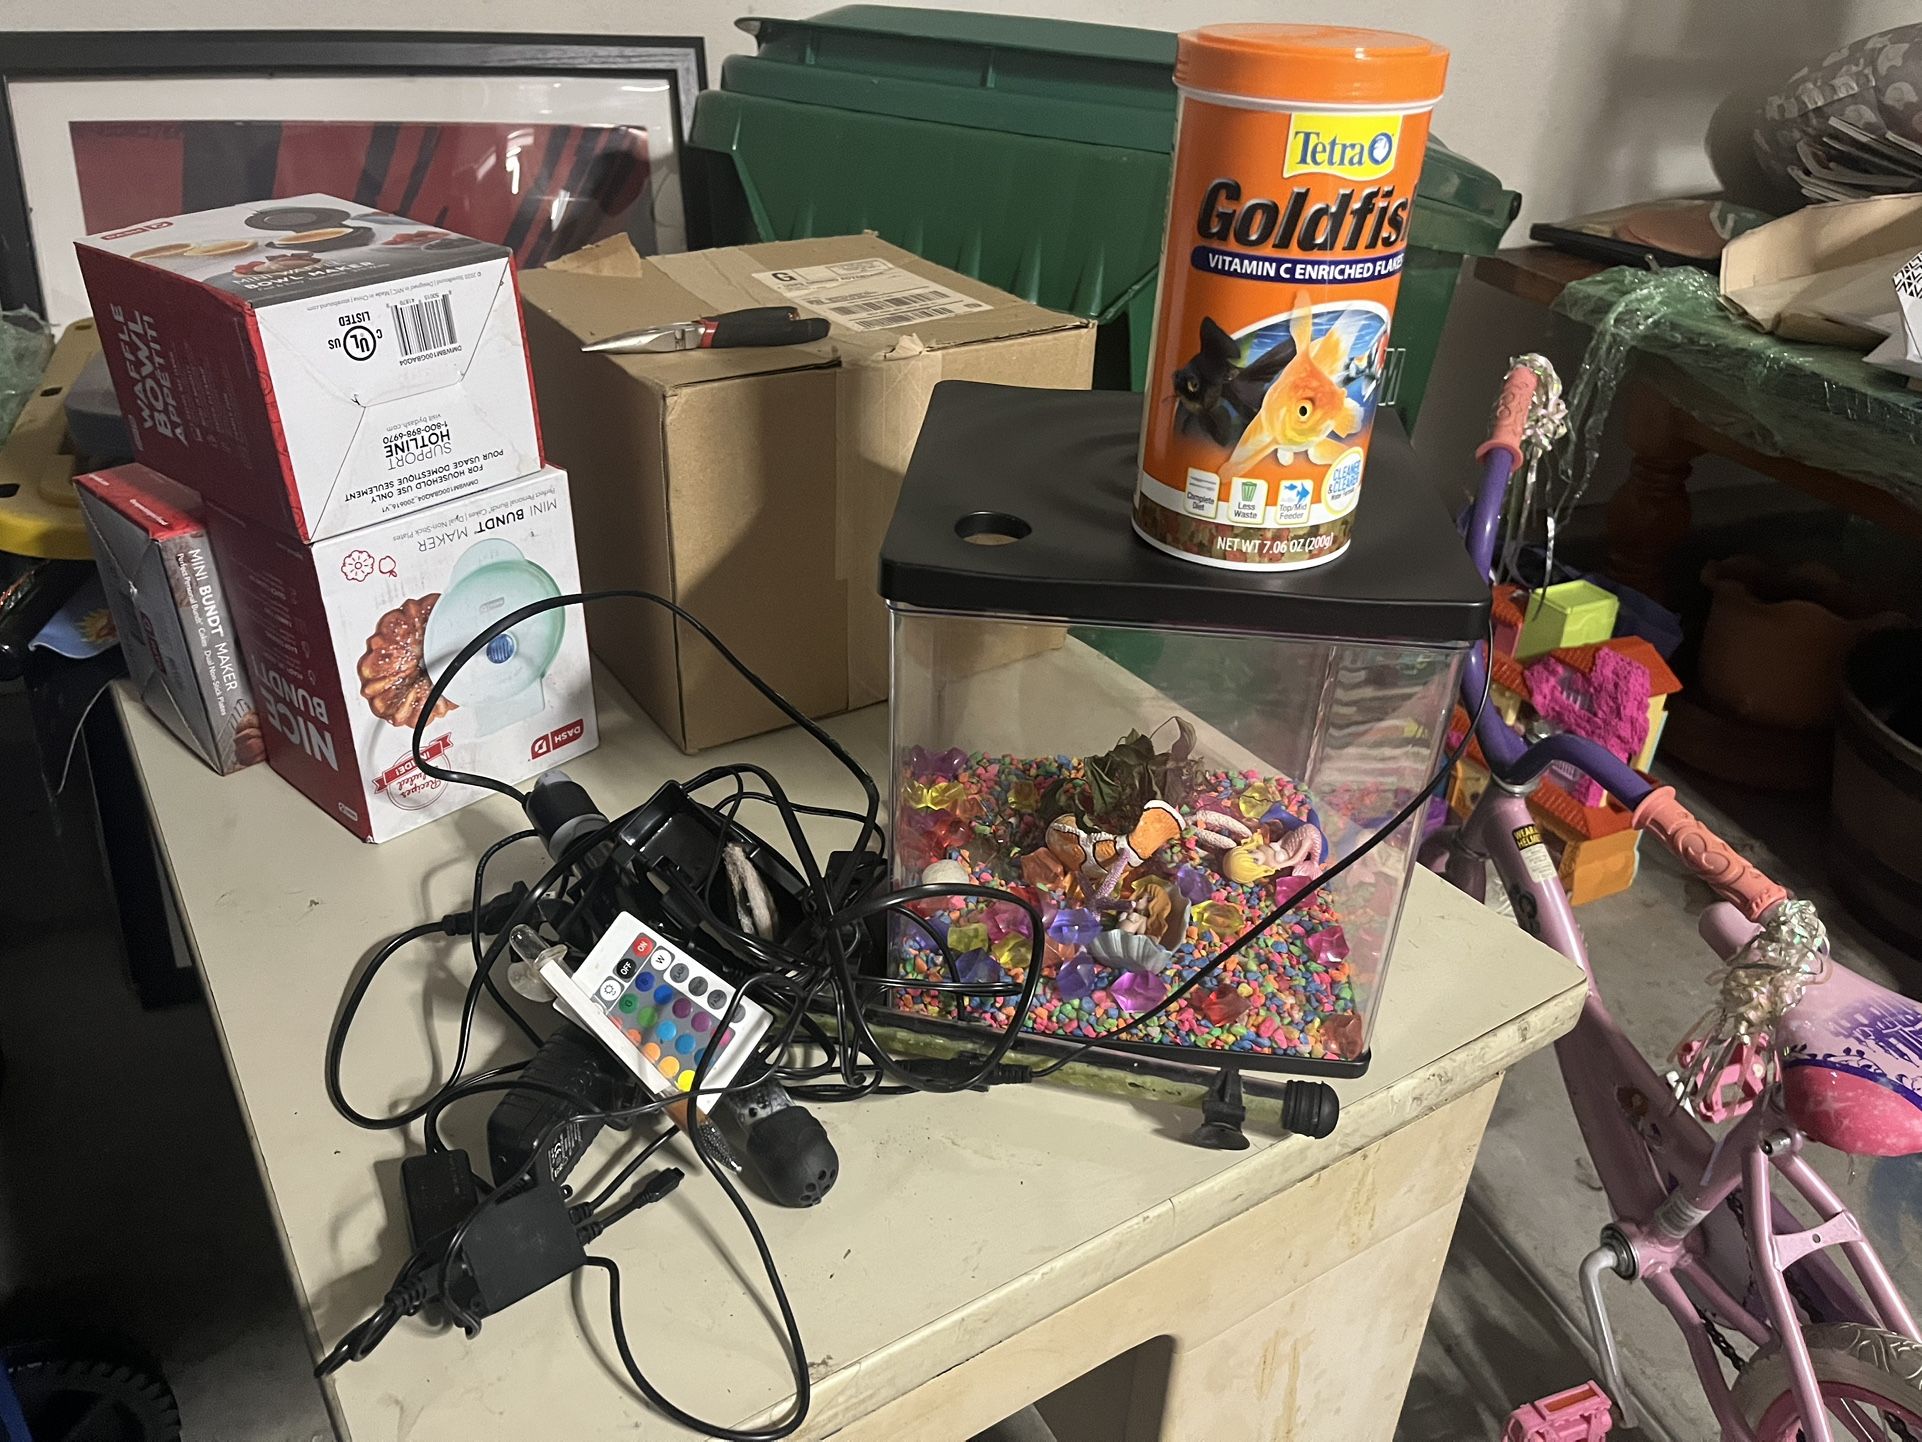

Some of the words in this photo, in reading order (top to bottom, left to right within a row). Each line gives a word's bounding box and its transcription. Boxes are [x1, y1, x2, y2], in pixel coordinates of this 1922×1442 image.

[1294, 130, 1366, 167] Tetra
[1196, 176, 1416, 252] Goldfis
[1208, 252, 1276, 278] VITAMIN
[1279, 262, 1292, 279] C
[1294, 263, 1374, 281] ENRICHED
[771, 271, 798, 283] G
[338, 311, 371, 327] LISTED
[375, 328, 383, 340] C
[327, 337, 342, 350] US
[109, 302, 154, 429] WAFFLE
[127, 309, 175, 439] BOWL
[382, 420, 449, 445] 1-800-898-6970
[383, 428, 451, 459] HOTLINE
[387, 441, 452, 471] SUPPORT
[452, 455, 481, 469] USAGE
[482, 448, 504, 461] POUR
[397, 463, 451, 487] DOMESTIQUE
[467, 463, 484, 475] FOR
[415, 469, 466, 491] HOUSEHOLD
[344, 479, 395, 502] SEULEMENT
[370, 490, 394, 504] ONLY
[397, 484, 413, 497] USE
[1186, 491, 1215, 506] Complete
[509, 492, 535, 507] Personal
[529, 498, 557, 517] MINI
[1237, 502, 1256, 511] Less
[1279, 502, 1308, 512] Top/Mid
[467, 508, 488, 520] Cakes
[1233, 509, 1258, 519] Waste
[1279, 511, 1304, 520] Feeder
[392, 529, 414, 542] Plates
[414, 519, 448, 536] Non-Stick
[417, 525, 468, 552] MAKER
[1216, 535, 1238, 551] NET
[1241, 538, 1261, 553] WT
[1262, 539, 1288, 555] 7.06
[1289, 537, 1303, 552] OZ
[1304, 531, 1335, 552] (200g)
[188, 548, 209, 581] MINI
[214, 641, 238, 692] MAKER
[203, 649, 215, 668] Dual
[259, 683, 340, 772] NICE
[554, 725, 582, 745] DASH
[394, 751, 431, 777] INIDE!
[400, 778, 442, 799] Recipes
[637, 940, 648, 952] ON
[620, 961, 633, 975] OFF
[655, 954, 666, 965] W
